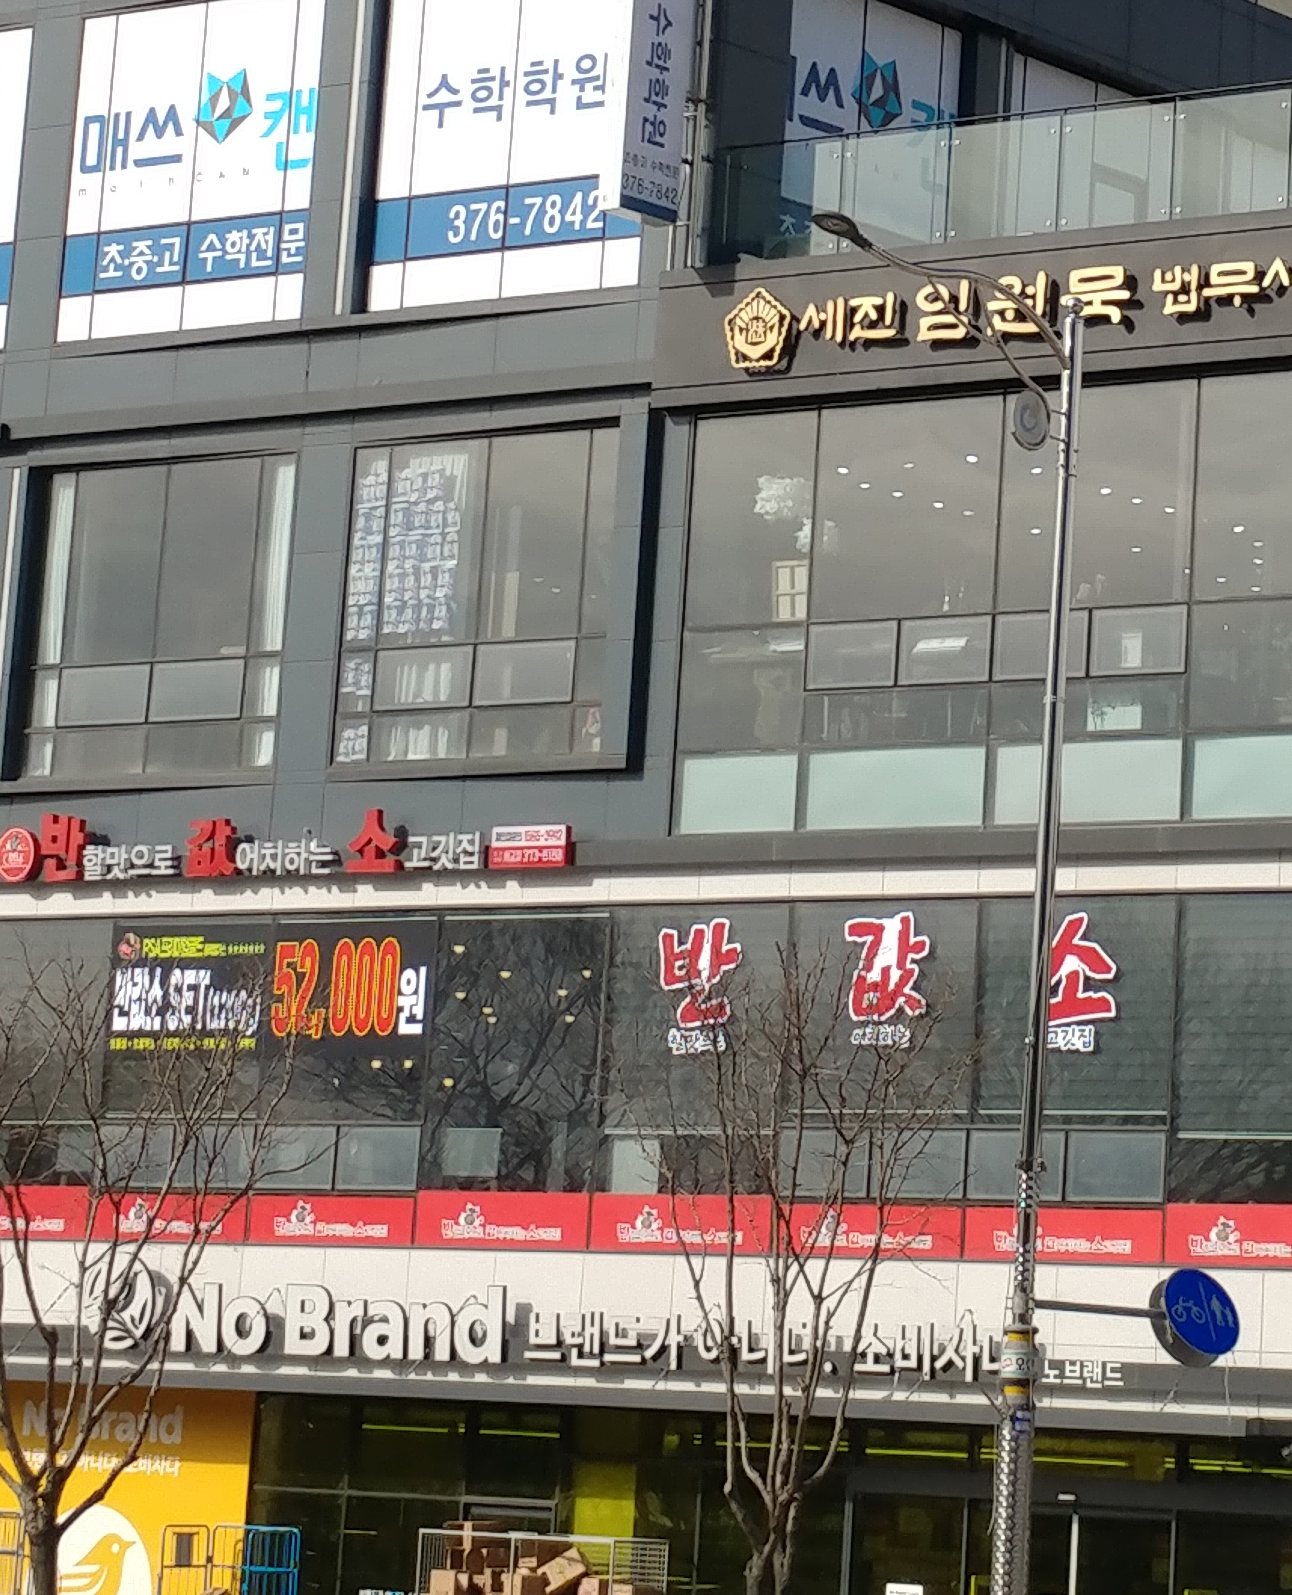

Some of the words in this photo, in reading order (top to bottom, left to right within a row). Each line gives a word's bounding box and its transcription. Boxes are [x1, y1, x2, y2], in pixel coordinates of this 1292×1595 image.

[421, 52, 609, 130] 수학학원
[198, 222, 305, 272] 수학전문
[448, 190, 605, 244] 376-7842
[799, 291, 898, 344] 세진
[171, 1281, 271, 1356] No
[283, 1282, 507, 1364] Brand
[524, 1310, 685, 1372] 브랜드가
[1042, 1358, 1124, 1388] 노브랜드
